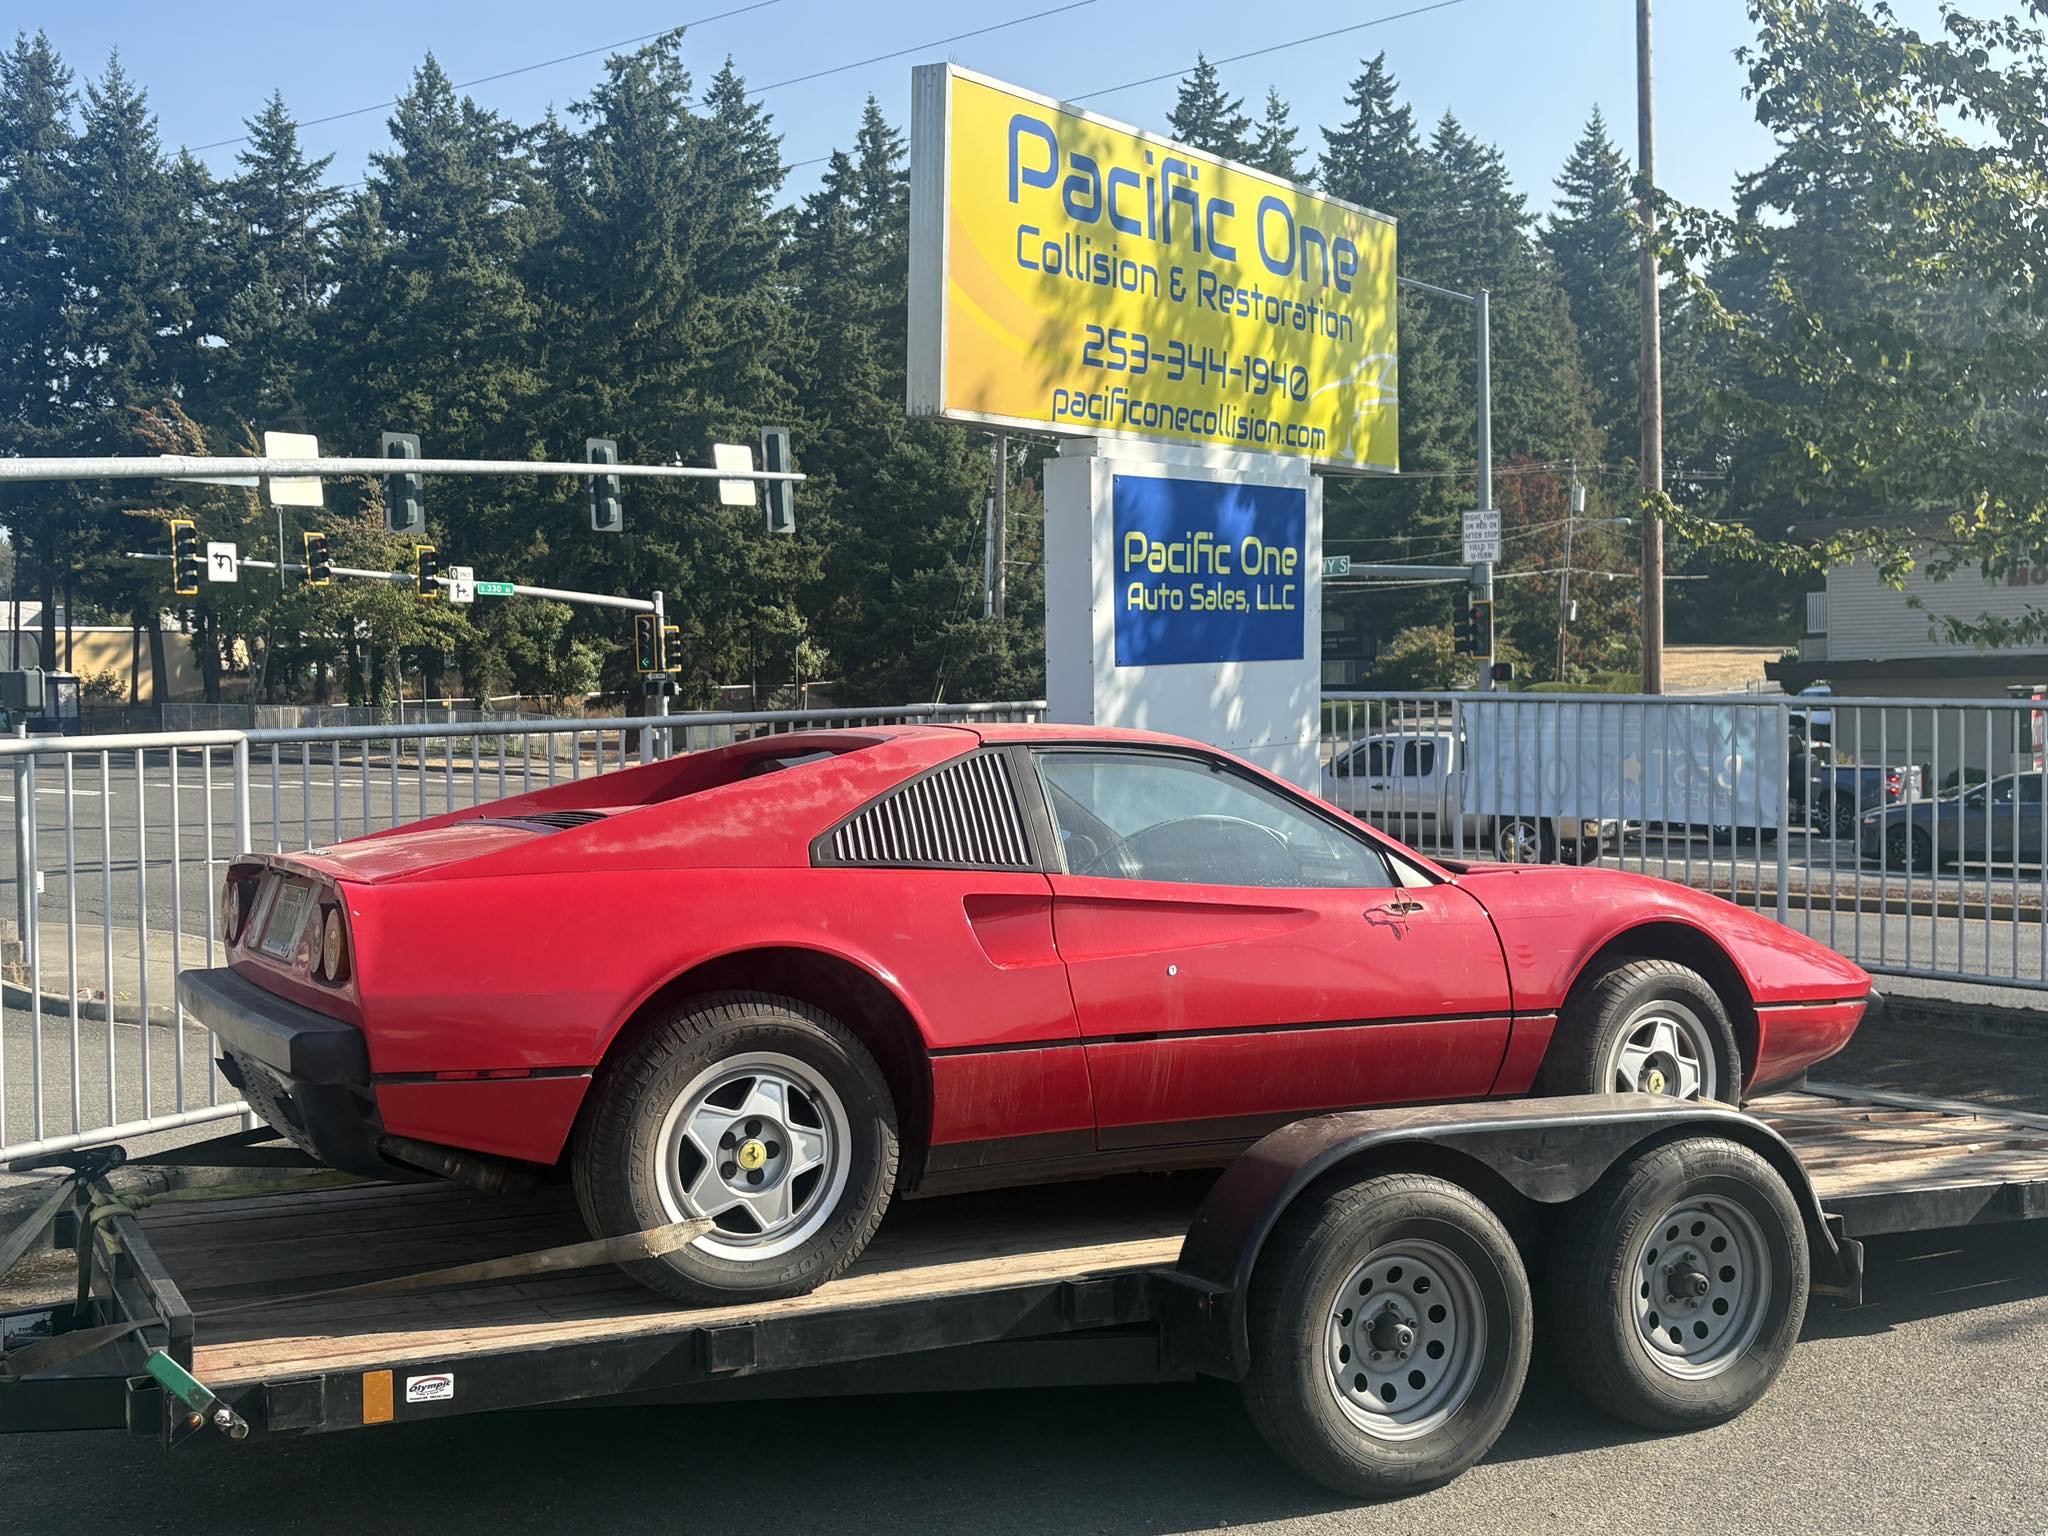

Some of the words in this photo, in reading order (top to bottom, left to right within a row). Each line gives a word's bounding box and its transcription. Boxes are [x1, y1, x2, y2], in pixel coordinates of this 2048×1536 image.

[1007, 113, 1237, 262] Pacific
[1257, 195, 1359, 294] One
[1016, 224, 1159, 298] Collision
[1170, 266, 1187, 302] &
[1197, 269, 1353, 343] Restoration
[1082, 323, 1309, 402] 253-344-1940
[1051, 387, 1326, 451] pacificonecollision.com
[1483, 513, 1498, 521] TURN
[1124, 531, 1231, 575] Pacific
[1240, 536, 1298, 576] One
[1339, 559, 1347, 573] S
[1127, 582, 1184, 611] Auto
[1190, 581, 1250, 614] Sales,
[1257, 584, 1296, 611] LLC
[409, 1380, 451, 1392] Olympic
